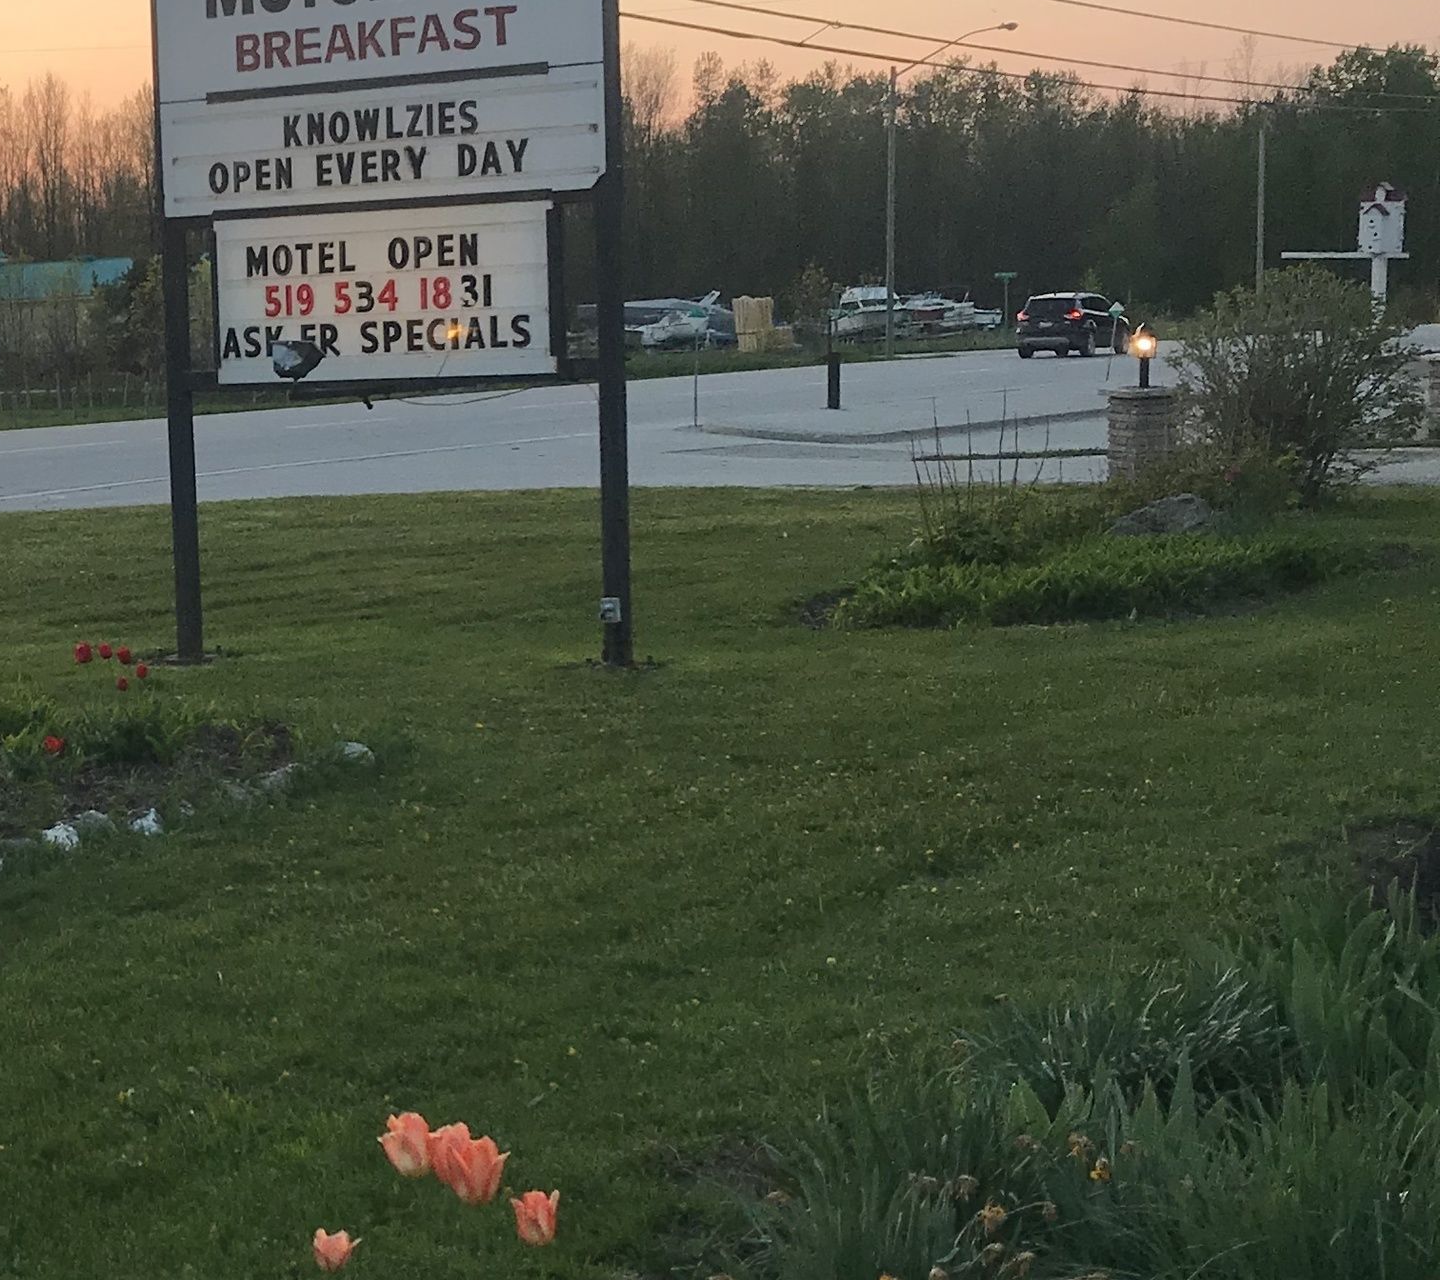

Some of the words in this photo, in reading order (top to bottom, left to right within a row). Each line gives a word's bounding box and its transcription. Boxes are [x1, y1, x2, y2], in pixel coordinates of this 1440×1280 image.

[236, 6, 517, 72] BREAKFAST
[283, 101, 479, 147] KNOWLZIES
[208, 158, 293, 194] OPEN
[316, 145, 427, 185] EVERY
[457, 139, 529, 177] DAY
[246, 240, 356, 277] MOTEL
[388, 233, 478, 269] OPEN
[265, 283, 314, 317] 519
[334, 279, 398, 314] 534
[420, 274, 493, 310] 1831
[223, 325, 283, 359] ASK
[360, 314, 531, 354] SPECIALS
